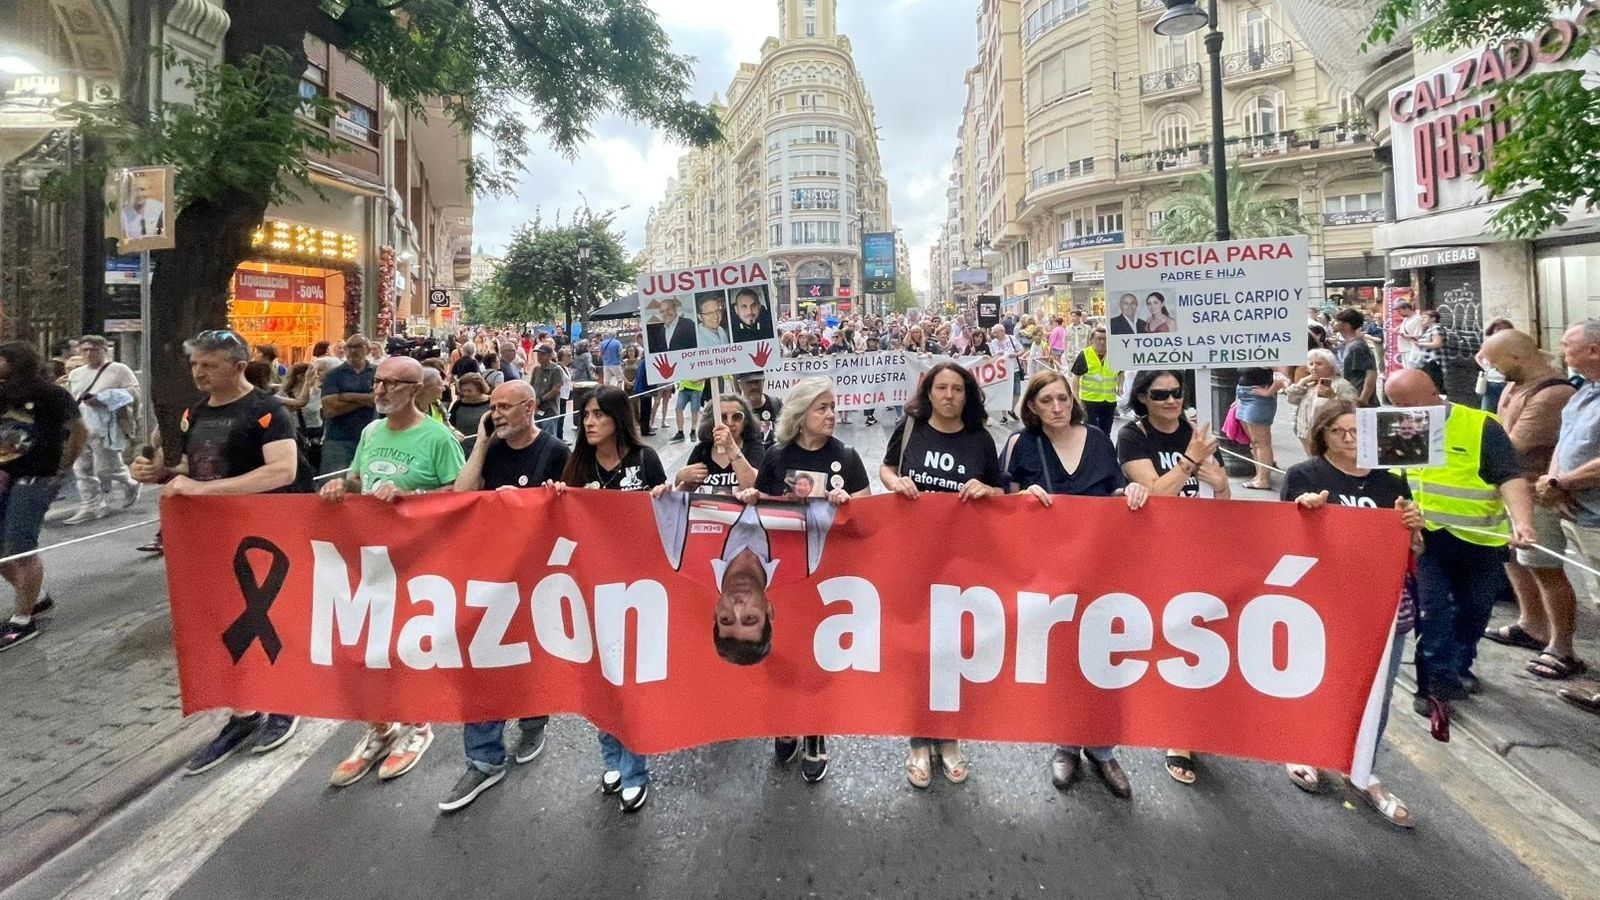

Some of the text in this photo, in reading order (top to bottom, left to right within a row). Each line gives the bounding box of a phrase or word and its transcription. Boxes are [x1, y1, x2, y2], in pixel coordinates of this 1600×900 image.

[1227, 242, 1293, 263] PARA
[1400, 248, 1476, 267] DAVID KEBAB
[642, 262, 768, 296] JUSTICIA
[1160, 267, 1246, 281] PADRE E HIJA
[297, 285, 324, 299] -50%
[1178, 288, 1303, 307] MIGUEL CARPIO Y
[1192, 306, 1289, 324] SARA CARPIO
[1122, 331, 1292, 348] Y TODAS LAS VICTIMAS
[681, 344, 743, 359] por mi marido
[1132, 345, 1279, 364] MAZÓN PRISIÓN
[697, 359, 714, 367] mis
[715, 356, 737, 367] hijos
[766, 355, 906, 373] ESTROS FAMILIARES
[767, 380, 790, 390] HAN
[836, 375, 858, 386] POR
[861, 372, 906, 384] VUESTRA
[924, 450, 966, 475] NO a
[909, 469, 966, 491] l'aforame
[309, 536, 1327, 712] Mazón a presó
